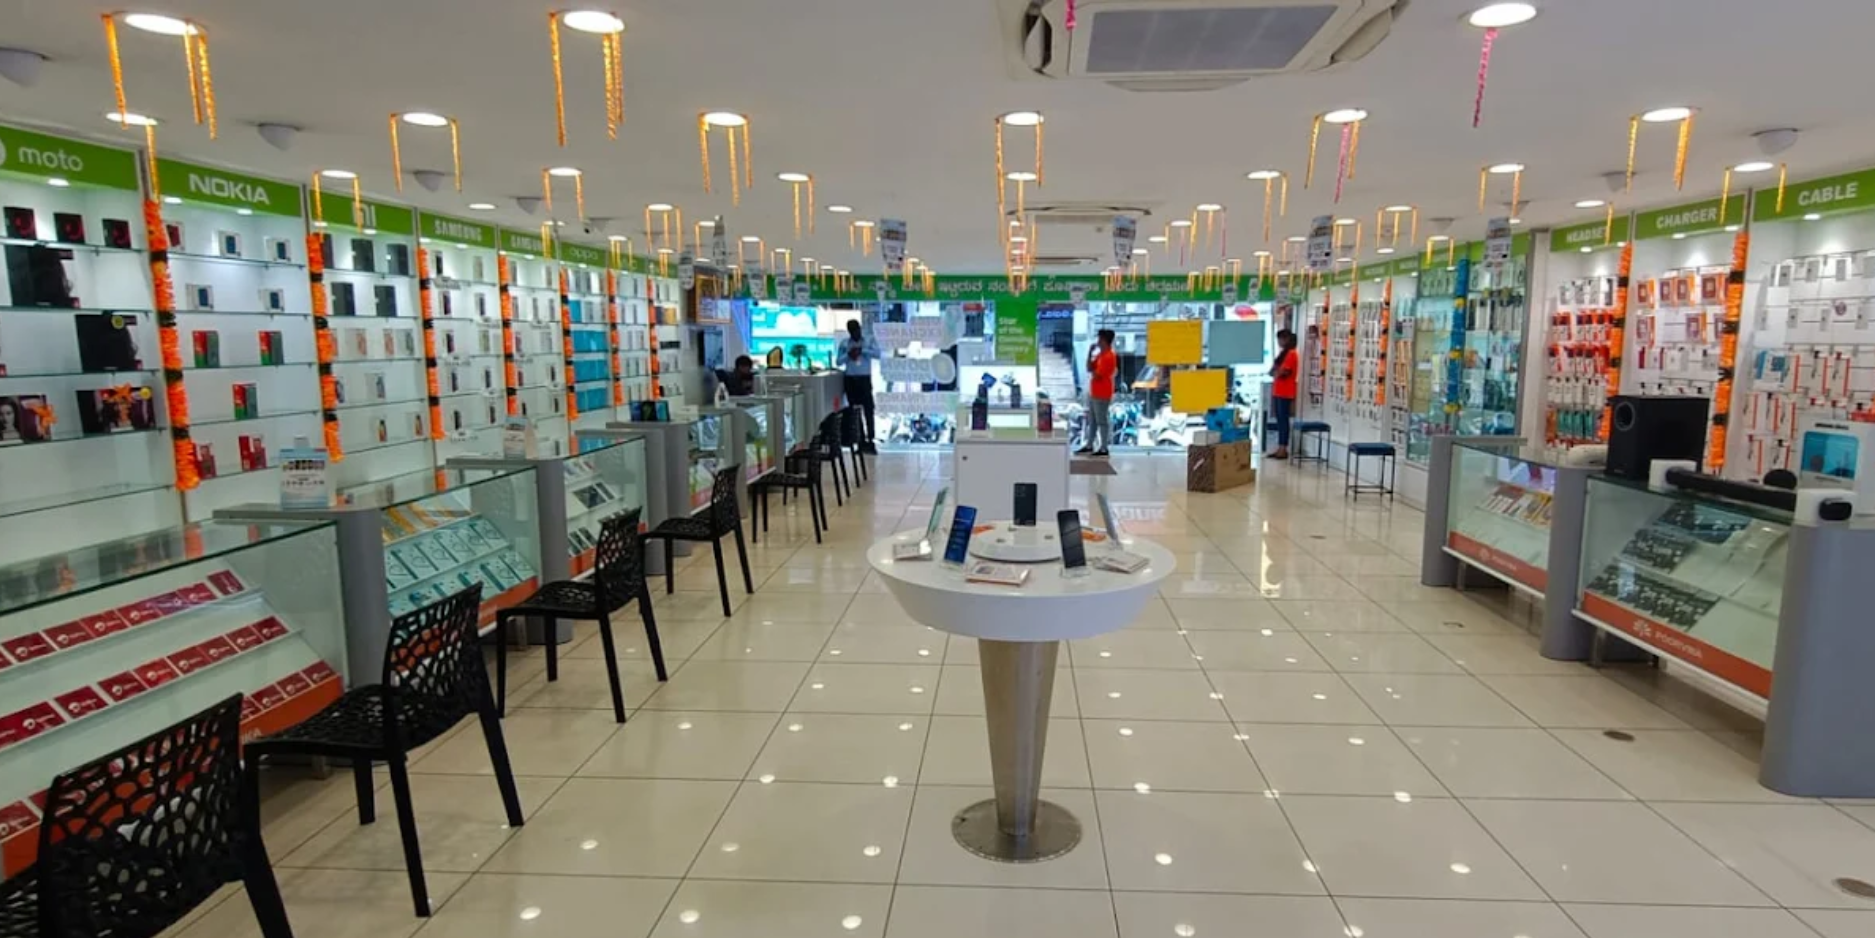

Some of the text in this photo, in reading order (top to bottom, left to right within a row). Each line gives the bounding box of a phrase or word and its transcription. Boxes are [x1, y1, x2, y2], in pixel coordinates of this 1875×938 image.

[18, 145, 84, 172] moto
[188, 172, 270, 205] NOKIA
[1797, 181, 1859, 206] CABLE
[1656, 206, 1717, 229] CHARGER
[434, 219, 482, 242] SAMSUNG
[1565, 226, 1609, 243] HEADSE
[510, 234, 545, 253] SAMSUN
